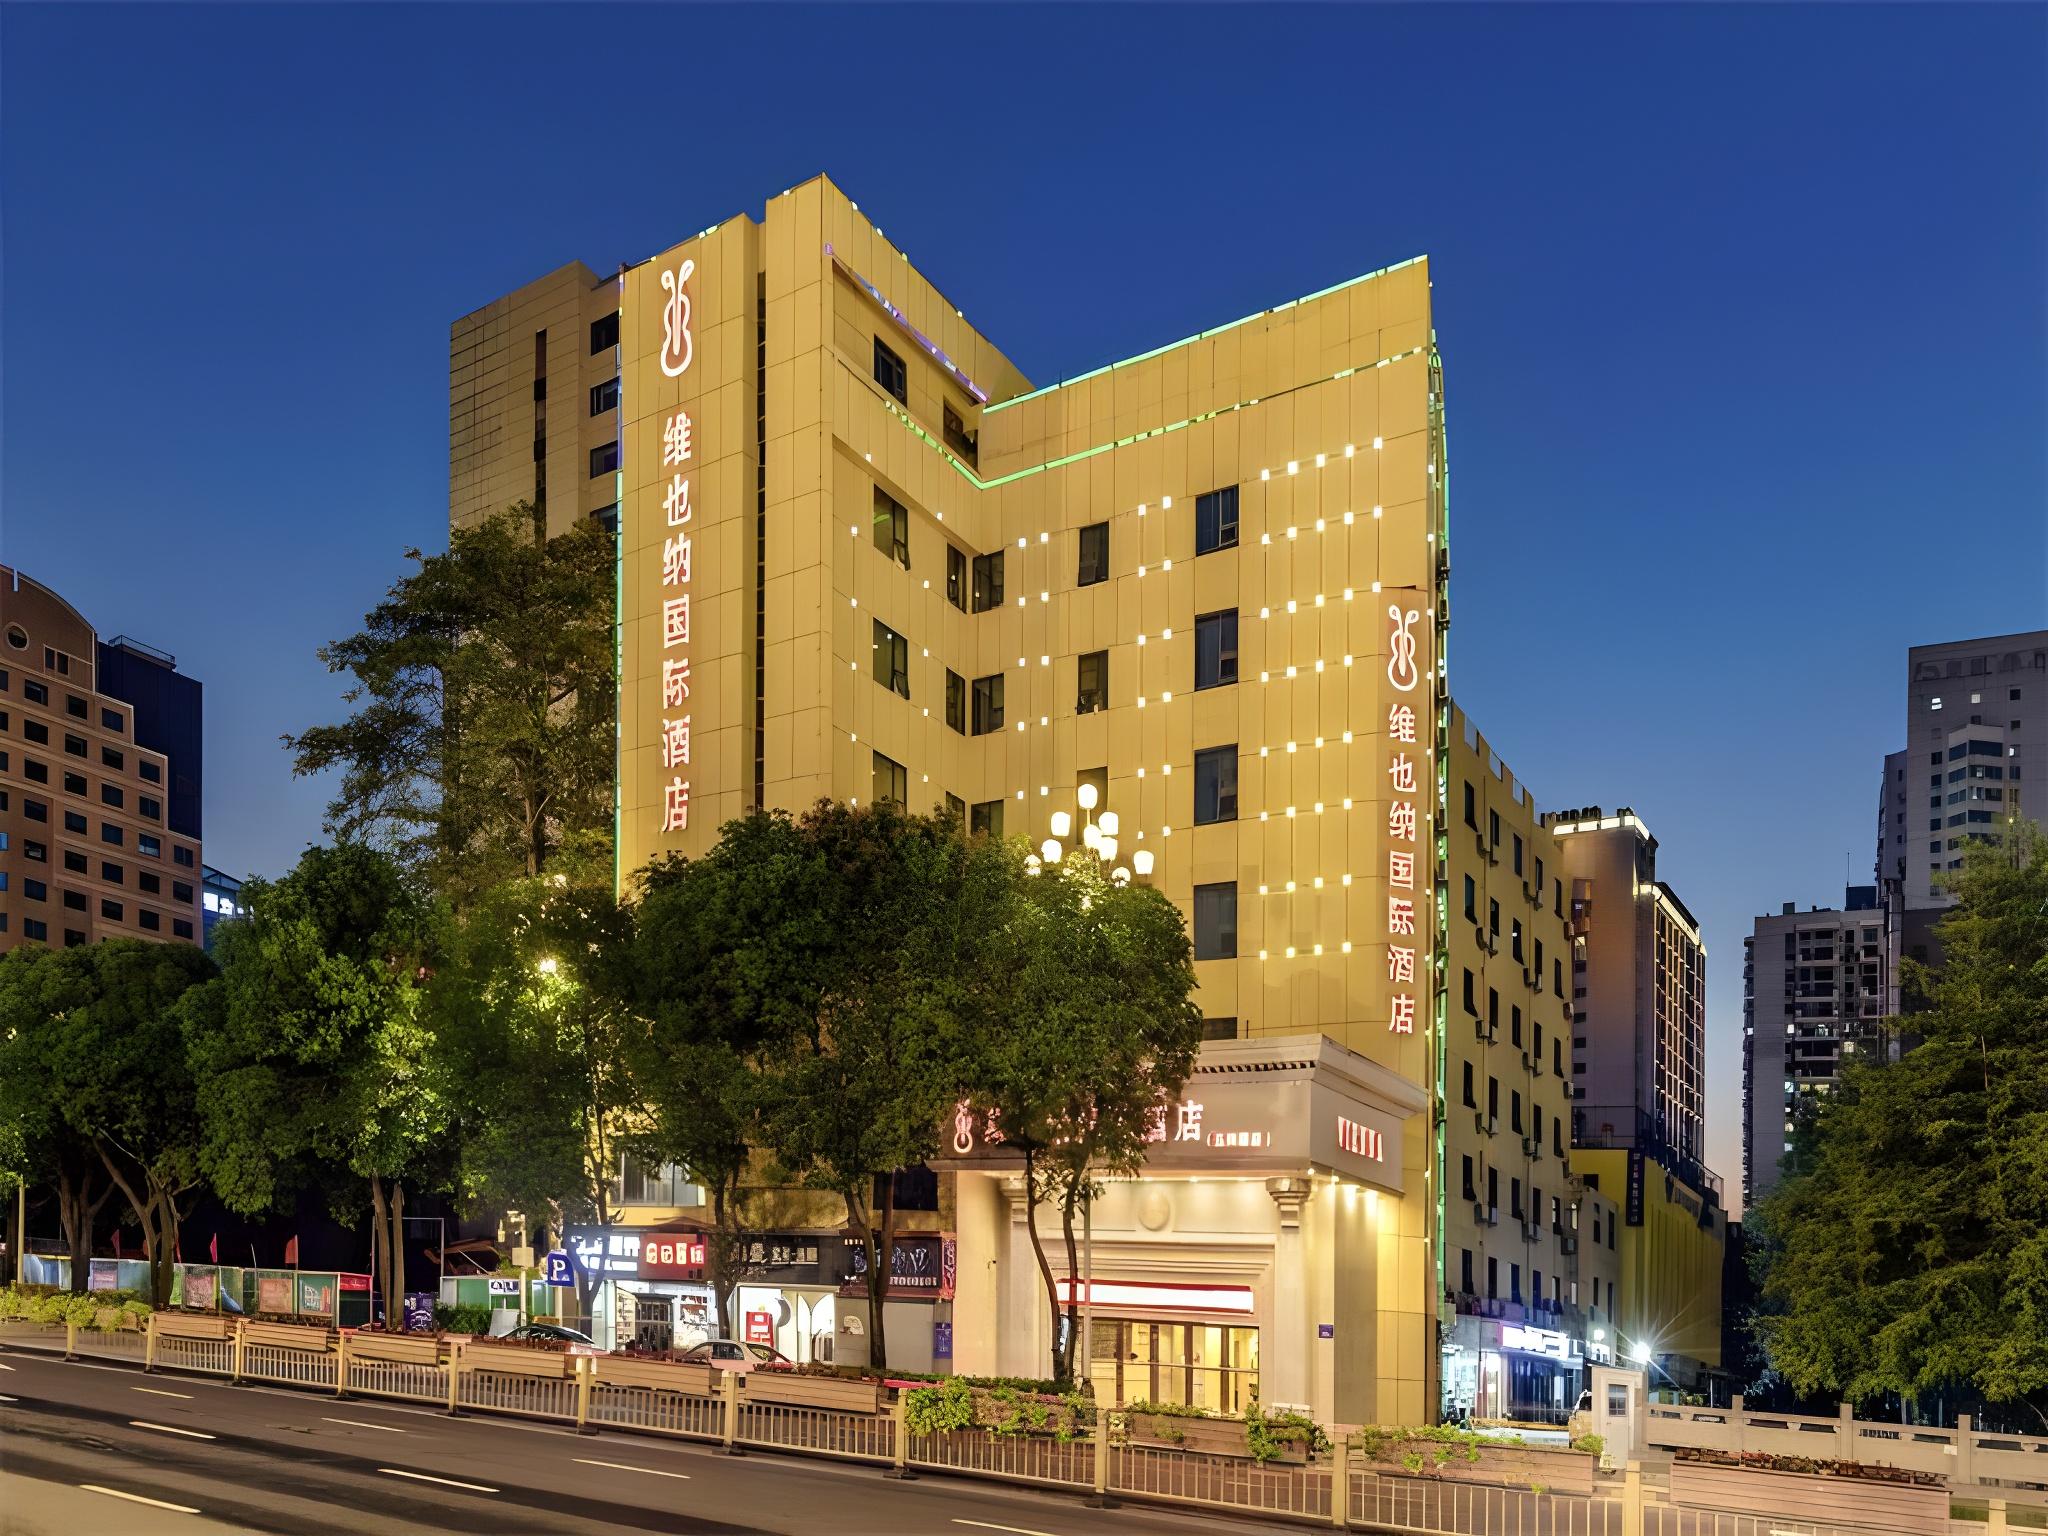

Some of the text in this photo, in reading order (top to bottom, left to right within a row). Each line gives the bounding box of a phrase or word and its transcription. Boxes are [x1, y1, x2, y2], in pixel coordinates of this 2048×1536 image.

[661, 411, 692, 832] 维也纳国际酒店
[552, 1259, 566, 1281] P
